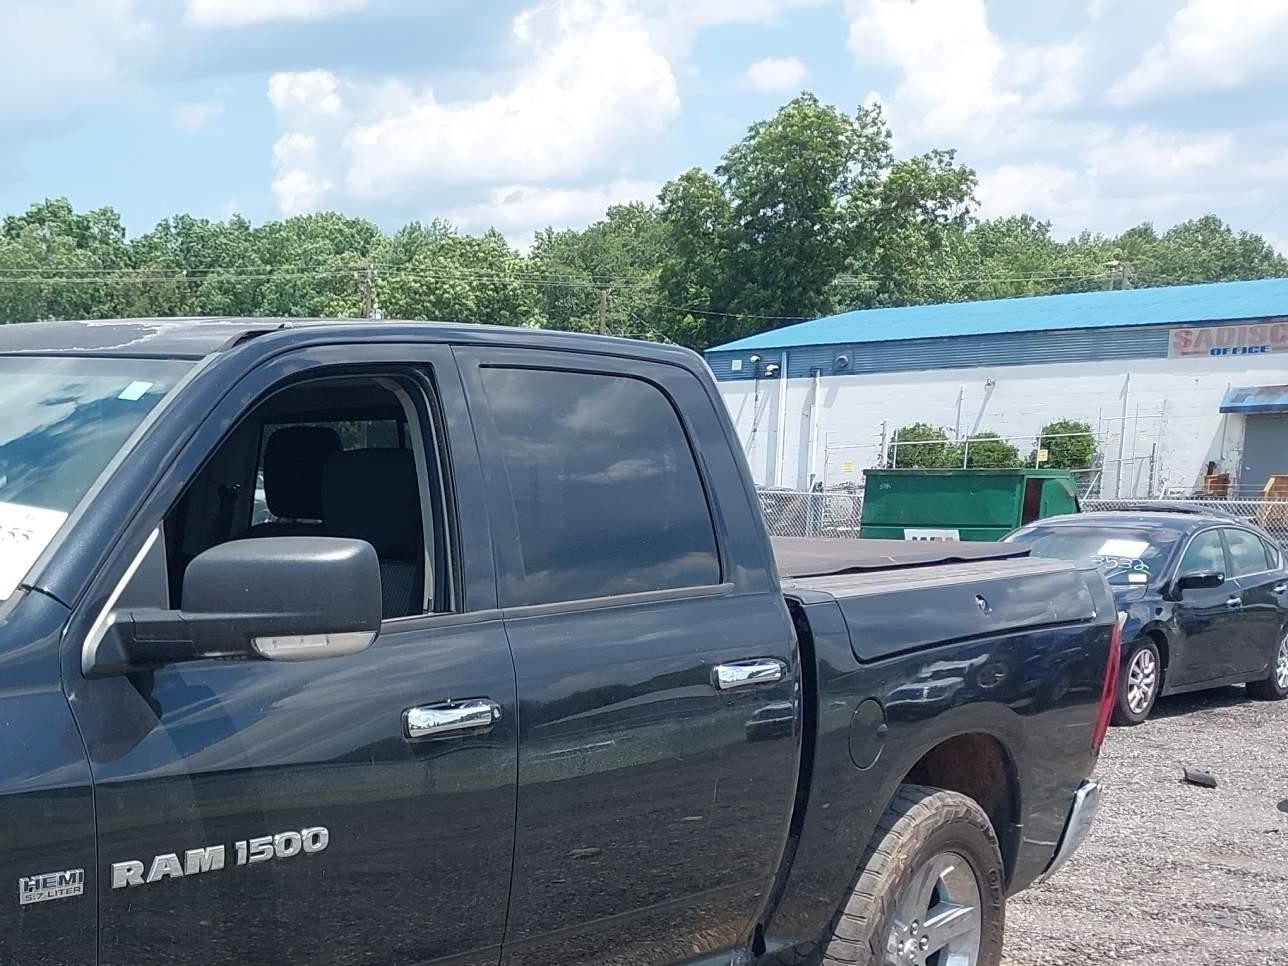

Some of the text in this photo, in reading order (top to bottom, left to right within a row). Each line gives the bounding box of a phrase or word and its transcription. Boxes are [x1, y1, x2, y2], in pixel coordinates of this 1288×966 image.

[1209, 345, 1271, 357] OFFICE
[111, 826, 330, 889] RAM 1500
[21, 870, 84, 893] HEMI
[25, 886, 82, 902] 5.7 LITER
